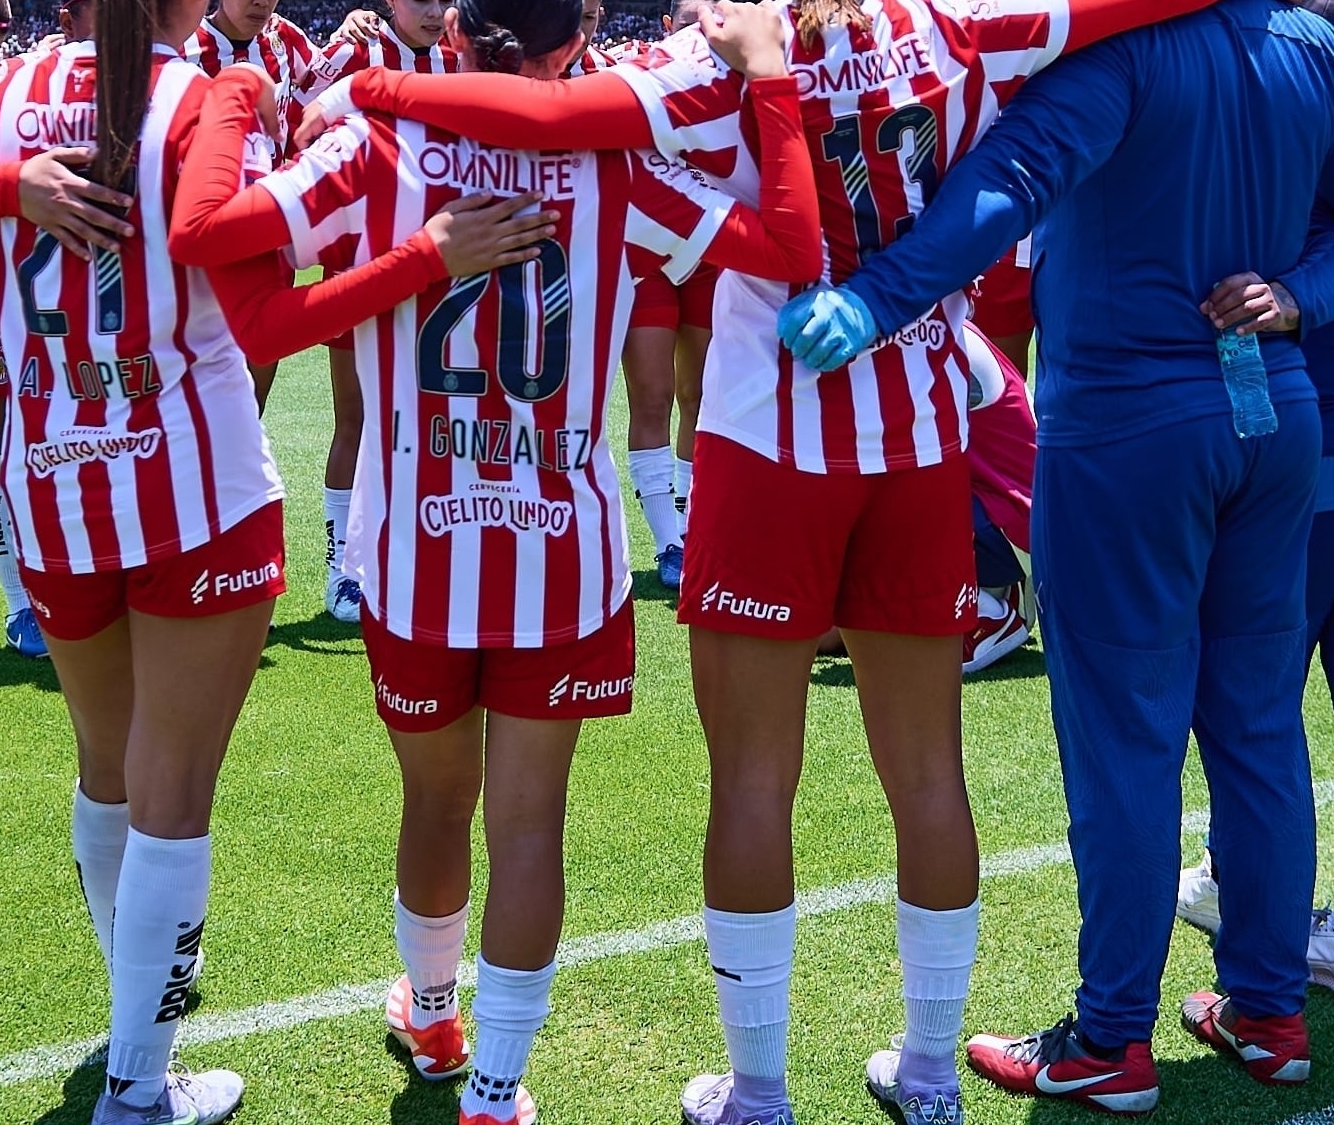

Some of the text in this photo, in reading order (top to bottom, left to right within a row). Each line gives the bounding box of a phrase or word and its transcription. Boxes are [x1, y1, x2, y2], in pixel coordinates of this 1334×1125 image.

[419, 146, 574, 195] OMNILIFE
[820, 103, 939, 263] 13
[415, 236, 572, 403] 20
[17, 353, 163, 401] A. LOPEZ
[30, 439, 95, 474] CIELITO
[392, 410, 590, 473] I. GONZALEZ
[425, 496, 568, 532] CIELITO LINDO
[214, 561, 280, 596] Futura
[716, 590, 792, 622] Futura
[381, 683, 439, 715] Futura
[571, 674, 635, 702] Futura
